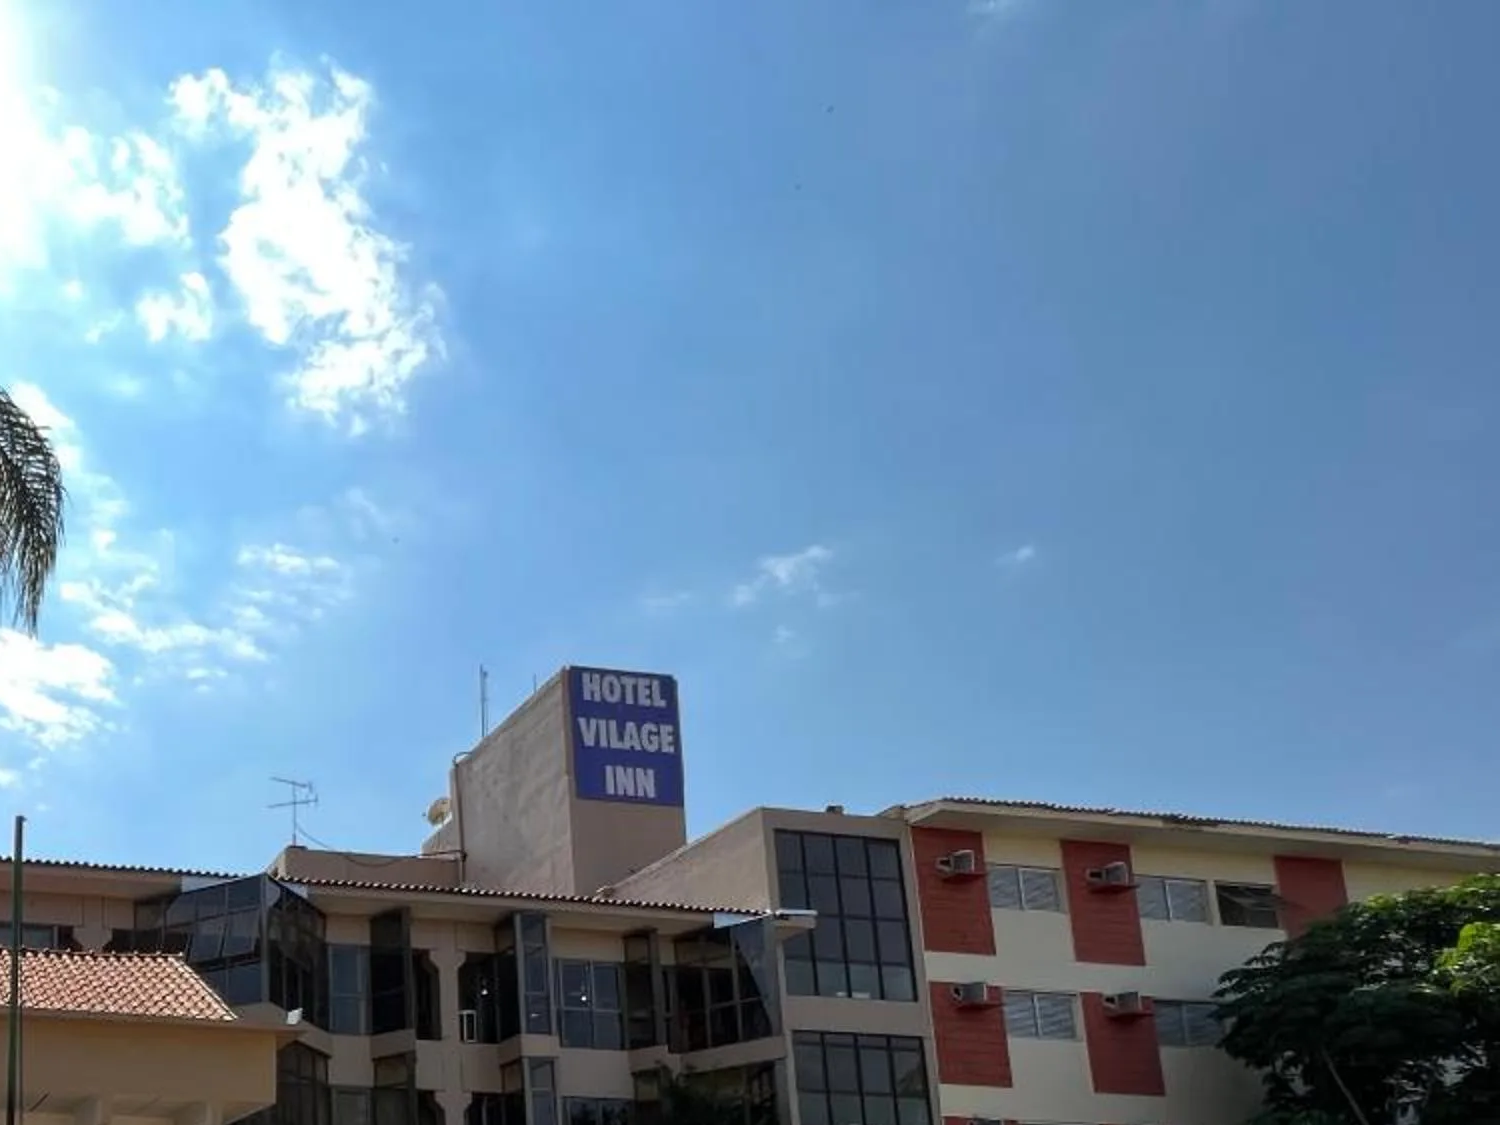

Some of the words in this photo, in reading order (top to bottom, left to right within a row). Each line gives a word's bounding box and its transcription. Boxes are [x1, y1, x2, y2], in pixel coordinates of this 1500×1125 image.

[581, 672, 666, 707] HOTEL
[577, 717, 675, 753] VILAGE
[605, 765, 656, 798] INN
